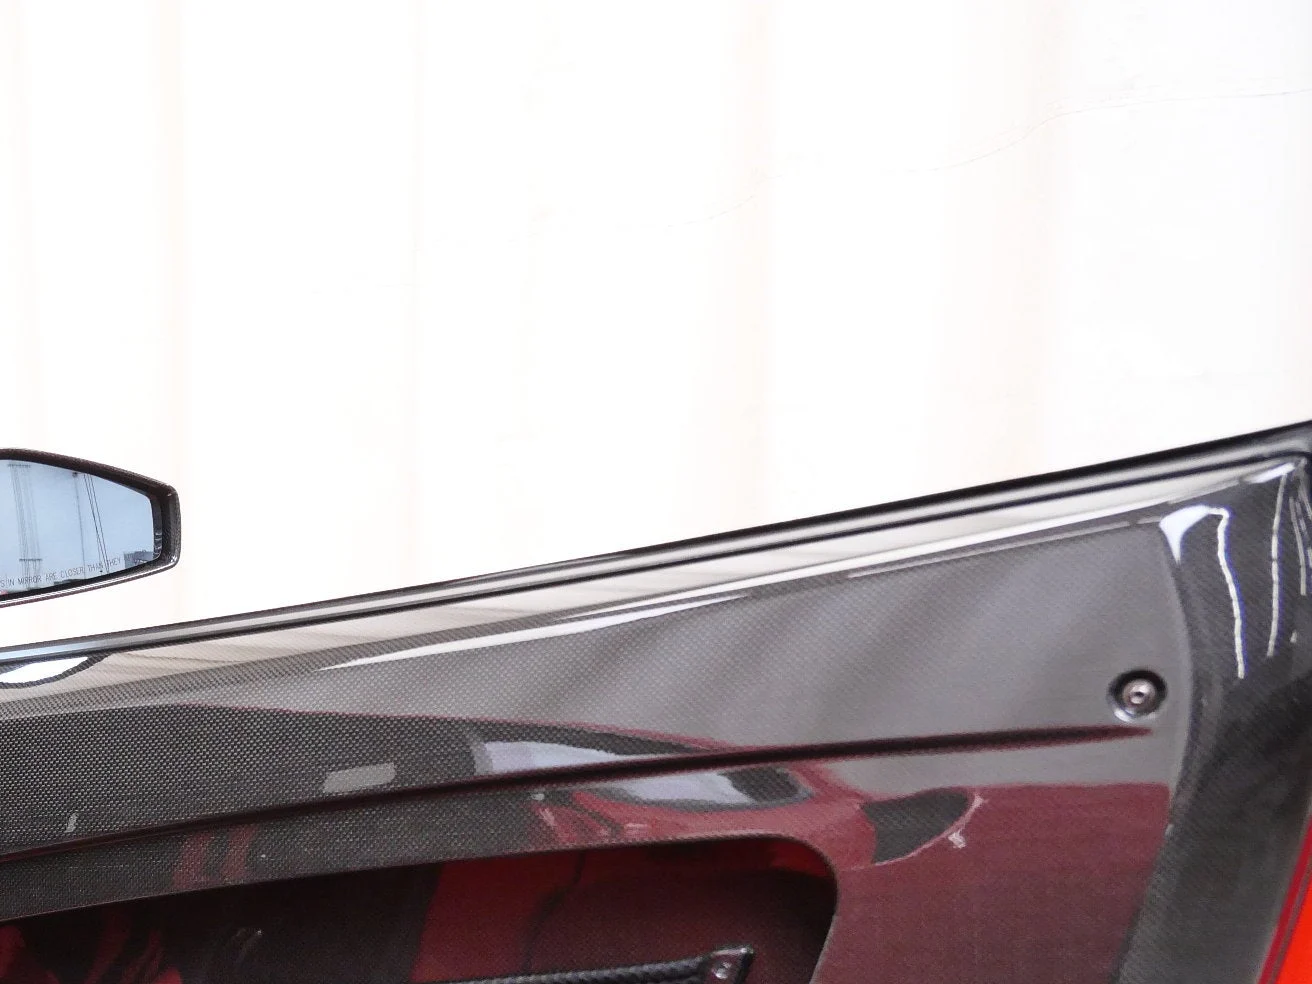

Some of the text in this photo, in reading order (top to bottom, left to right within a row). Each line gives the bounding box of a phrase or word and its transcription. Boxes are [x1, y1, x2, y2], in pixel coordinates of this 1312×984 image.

[6, 578, 15, 587] IN
[17, 574, 42, 585] MIRROR
[45, 572, 57, 582] ARE
[60, 566, 85, 578] CLOSER
[87, 561, 104, 572] THAN
